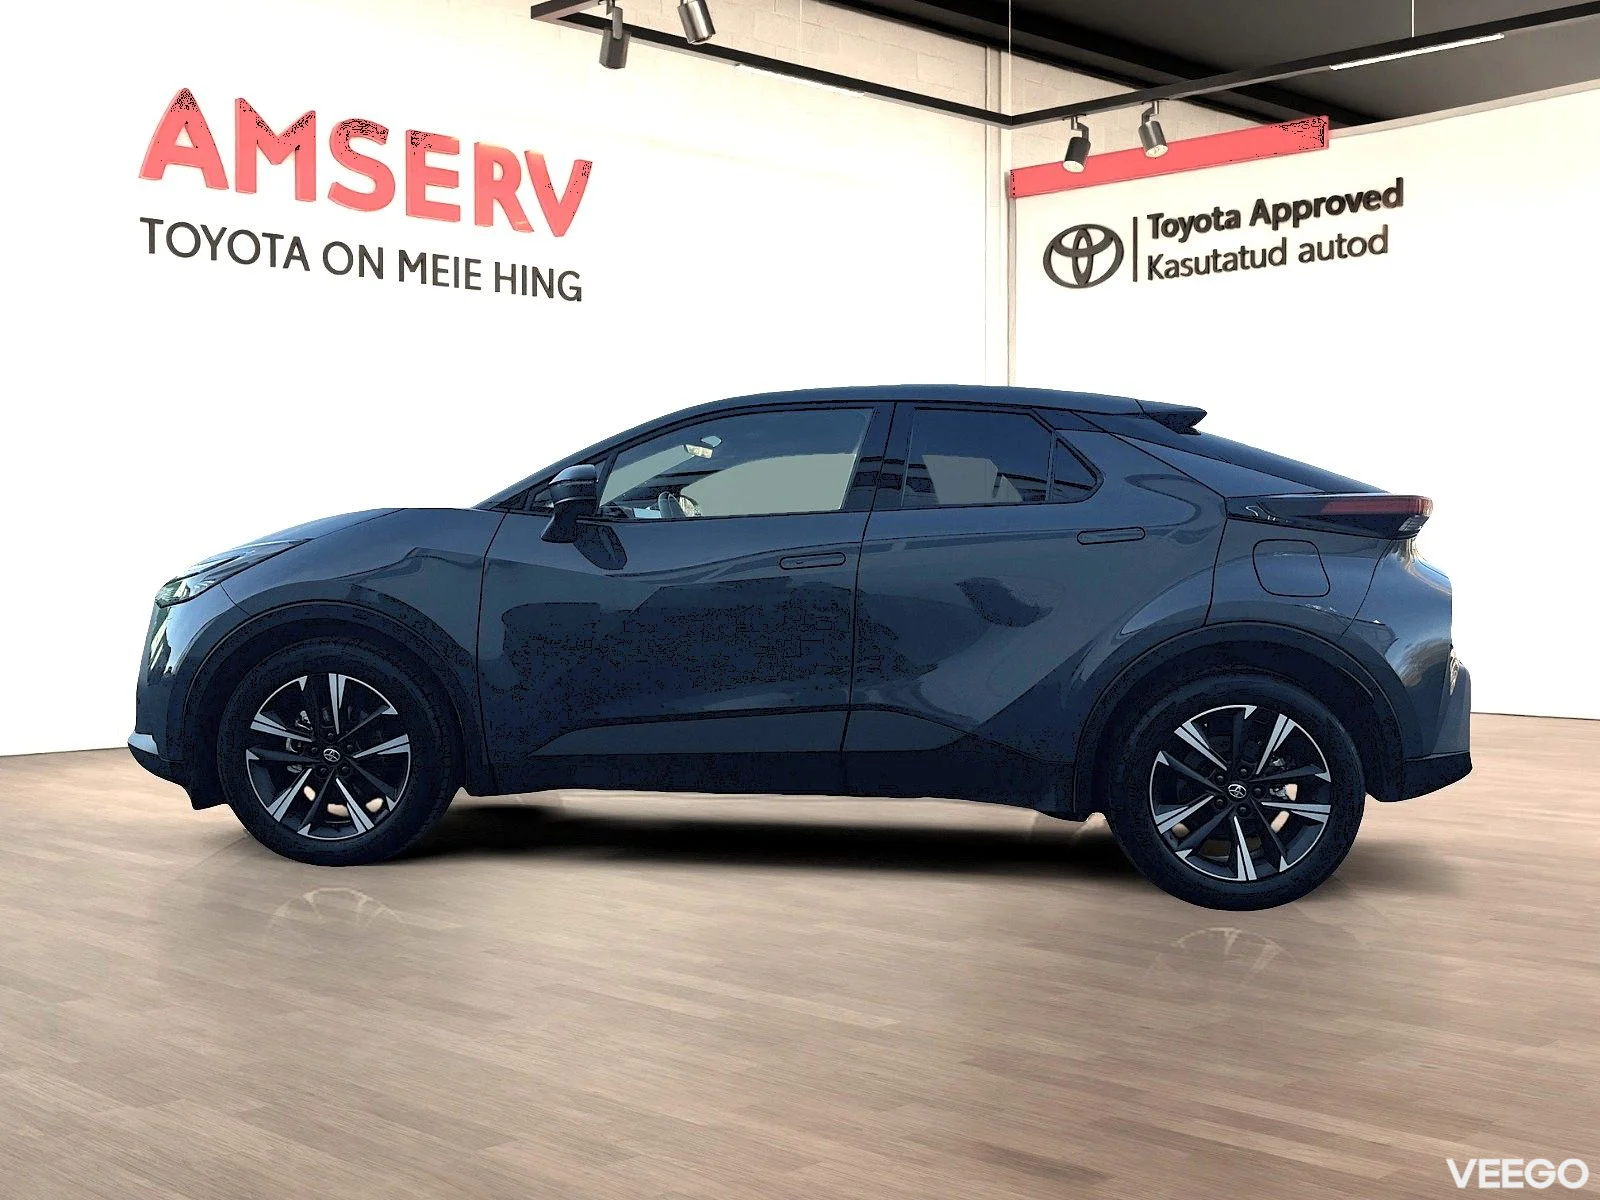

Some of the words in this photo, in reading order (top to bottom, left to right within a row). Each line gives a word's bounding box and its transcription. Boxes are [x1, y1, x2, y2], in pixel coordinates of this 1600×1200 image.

[139, 87, 593, 238] AMSERV
[1147, 206, 1242, 244] Toyota
[1249, 177, 1405, 232] Approved
[139, 216, 311, 272] TOYOTA
[322, 240, 384, 280] ON
[398, 249, 482, 291] MEIE
[494, 261, 583, 302] HING
[1147, 236, 1287, 281] Kasutatud
[1298, 224, 1389, 264] autod
